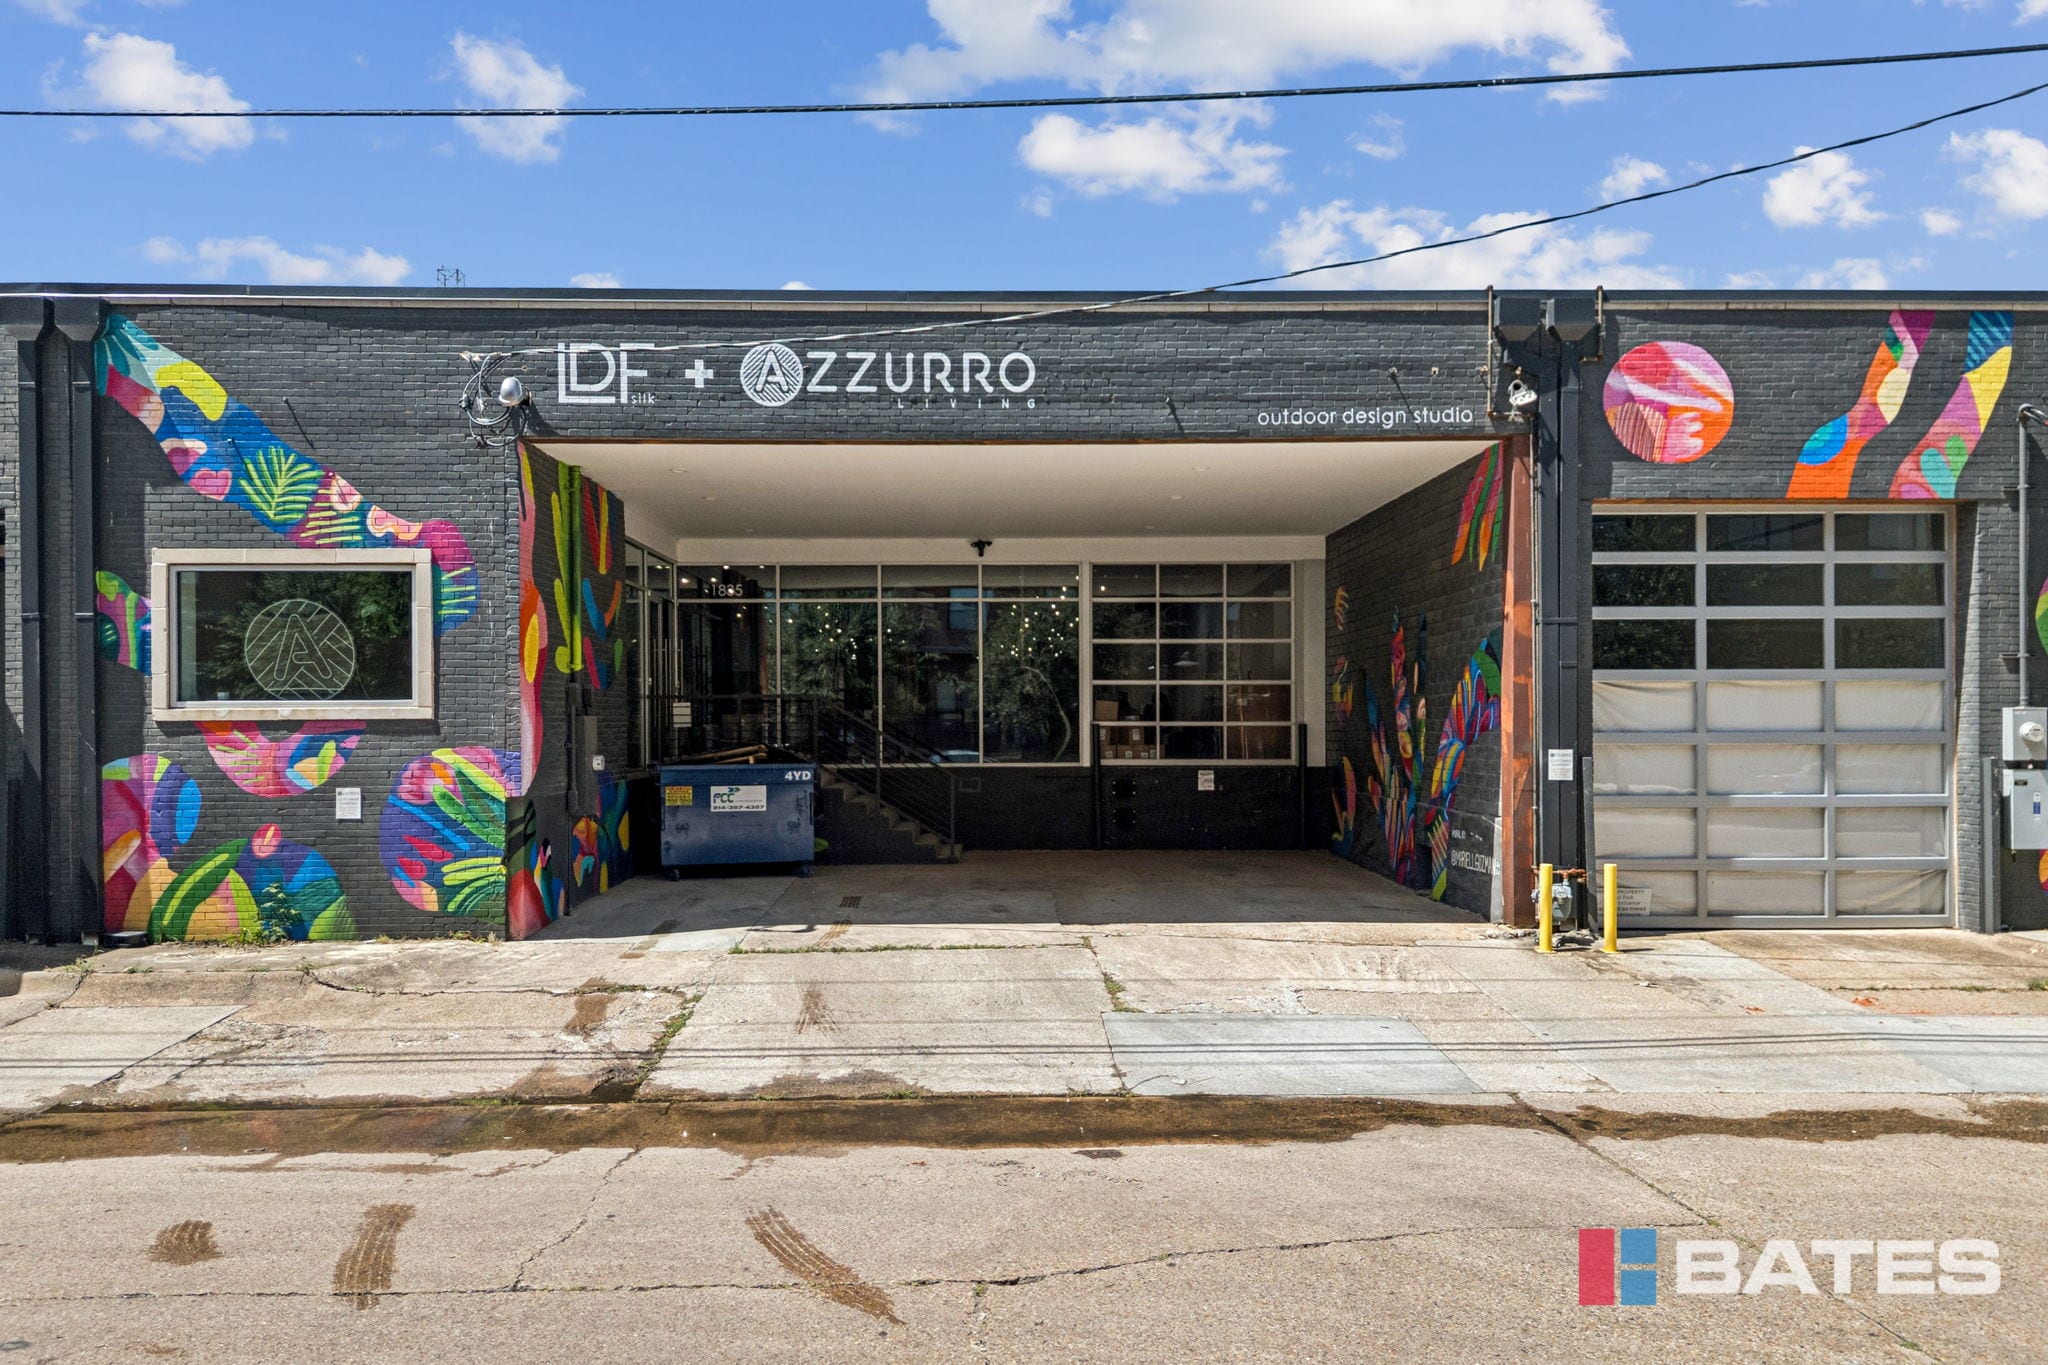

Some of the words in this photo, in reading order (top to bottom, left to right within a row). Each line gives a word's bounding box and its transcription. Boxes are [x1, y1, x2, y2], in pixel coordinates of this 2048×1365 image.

[752, 349, 1036, 395] AZZURRO
[631, 393, 655, 405] silk
[897, 398, 1036, 409] LIVING
[1257, 407, 1337, 425] outdoor
[1342, 407, 1404, 429] design
[1412, 406, 1474, 424] studio
[784, 771, 812, 781] 4YD
[713, 792, 735, 804] FCC
